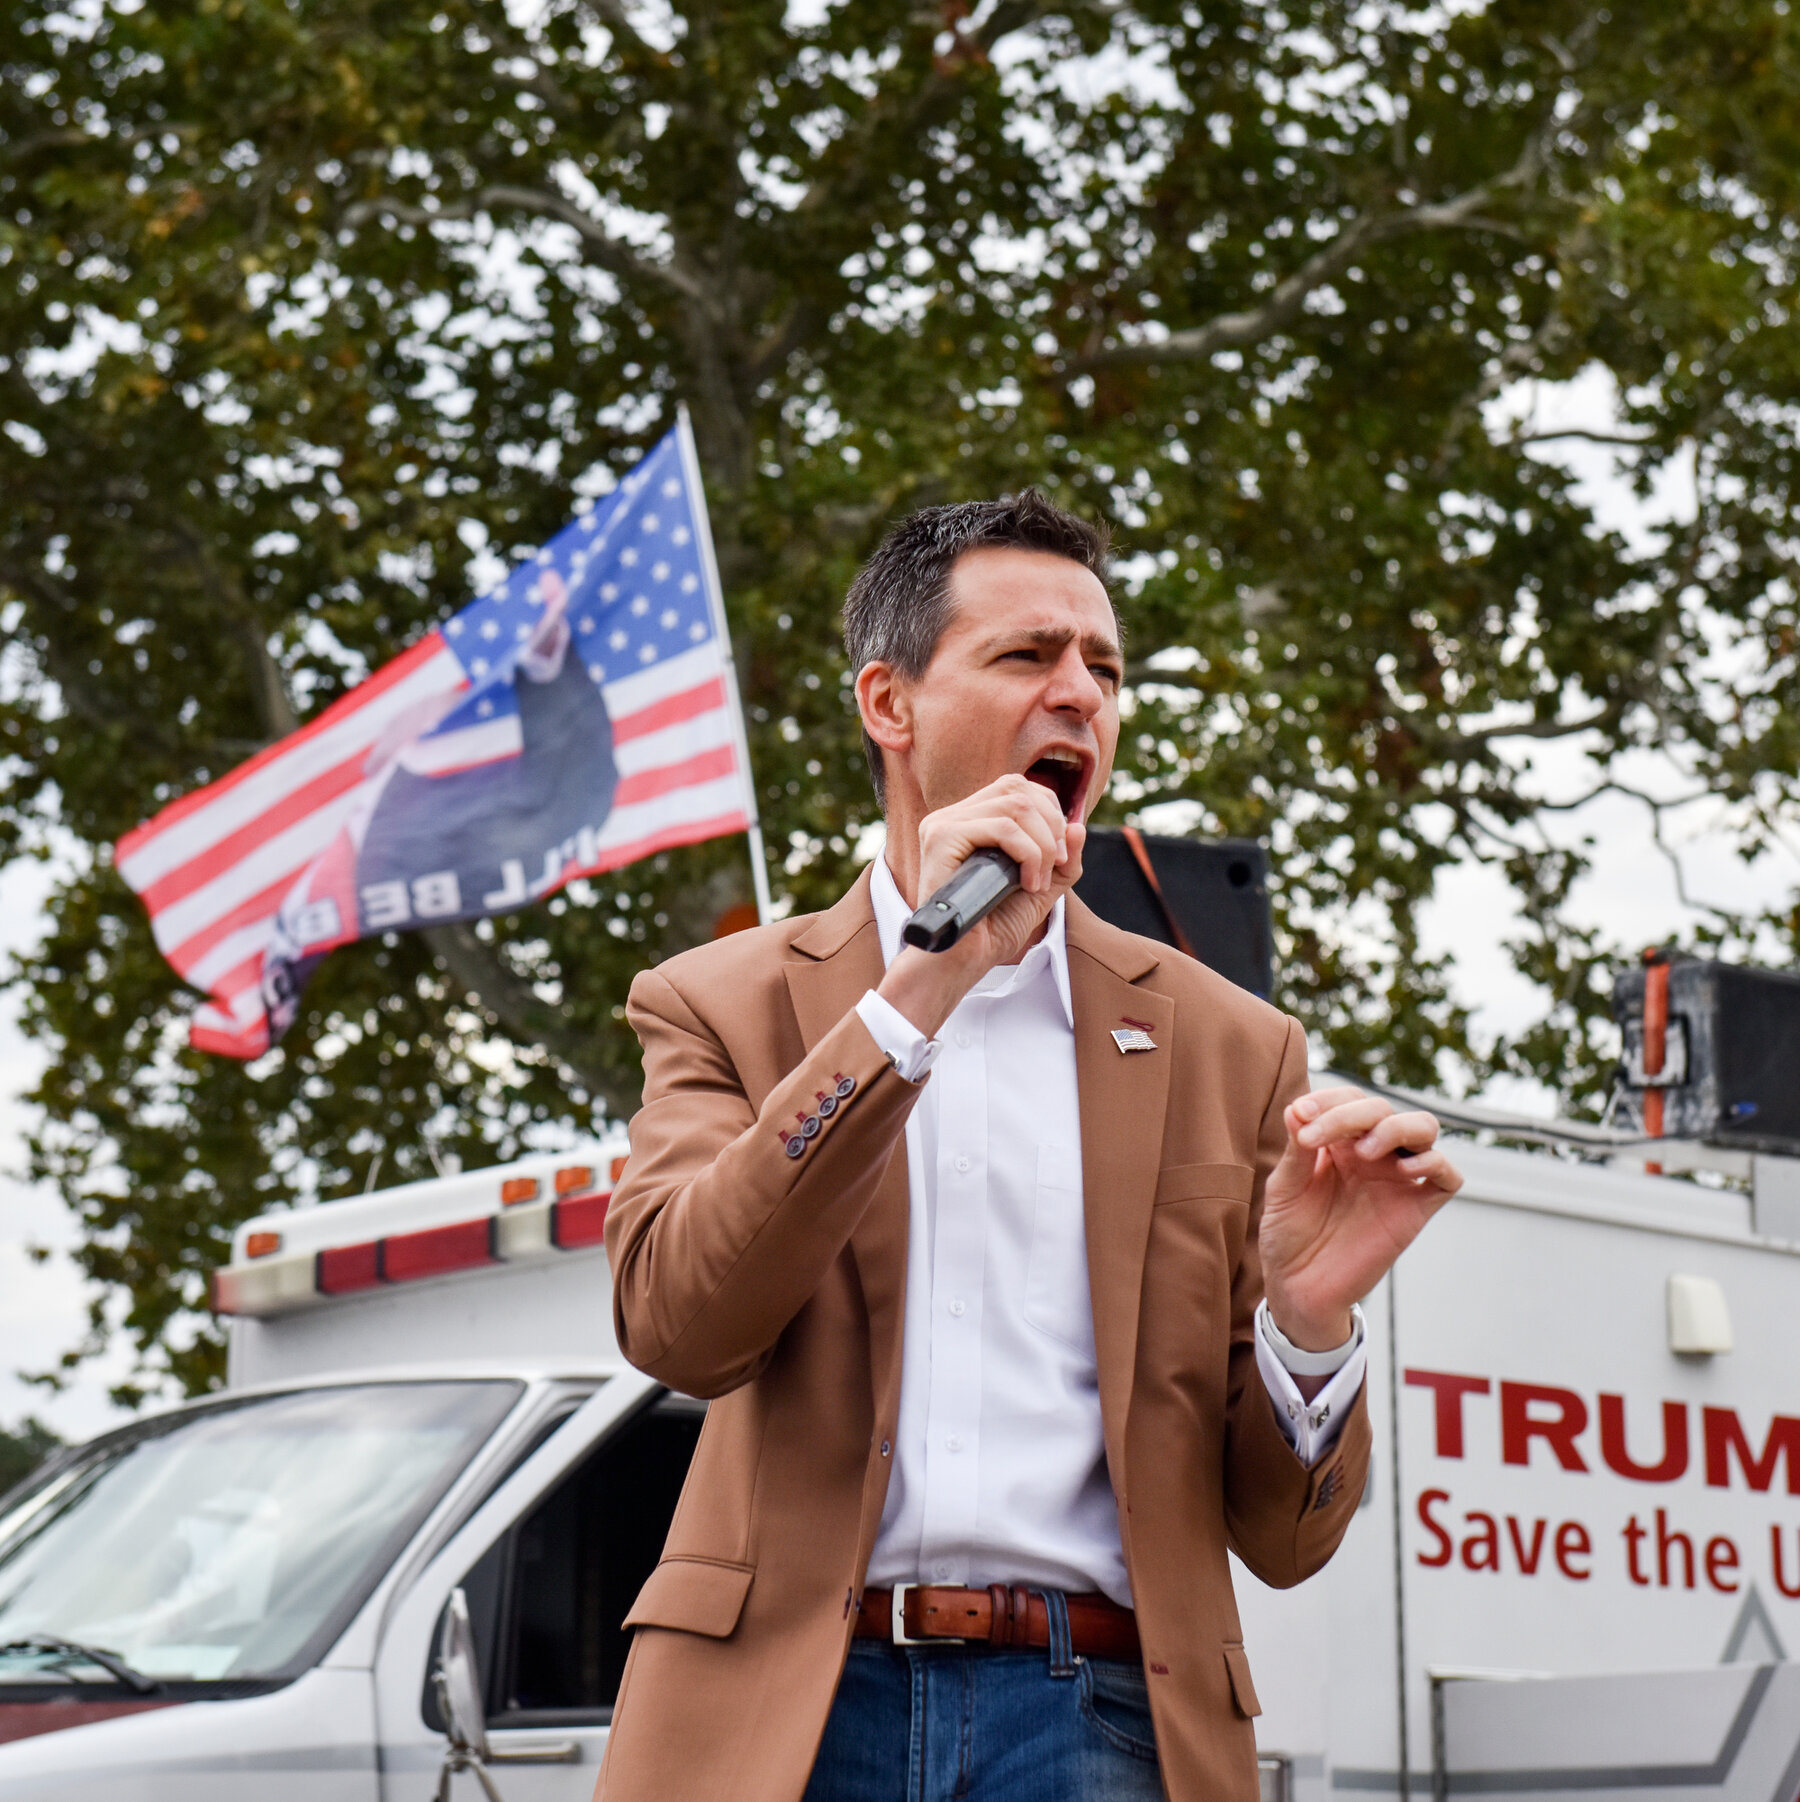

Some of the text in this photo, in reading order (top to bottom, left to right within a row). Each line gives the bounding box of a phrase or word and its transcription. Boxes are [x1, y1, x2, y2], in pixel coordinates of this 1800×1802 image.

[1404, 1367, 1800, 1497] TRUM
[1416, 1488, 1592, 1580] Save
[1622, 1508, 1740, 1593] the
